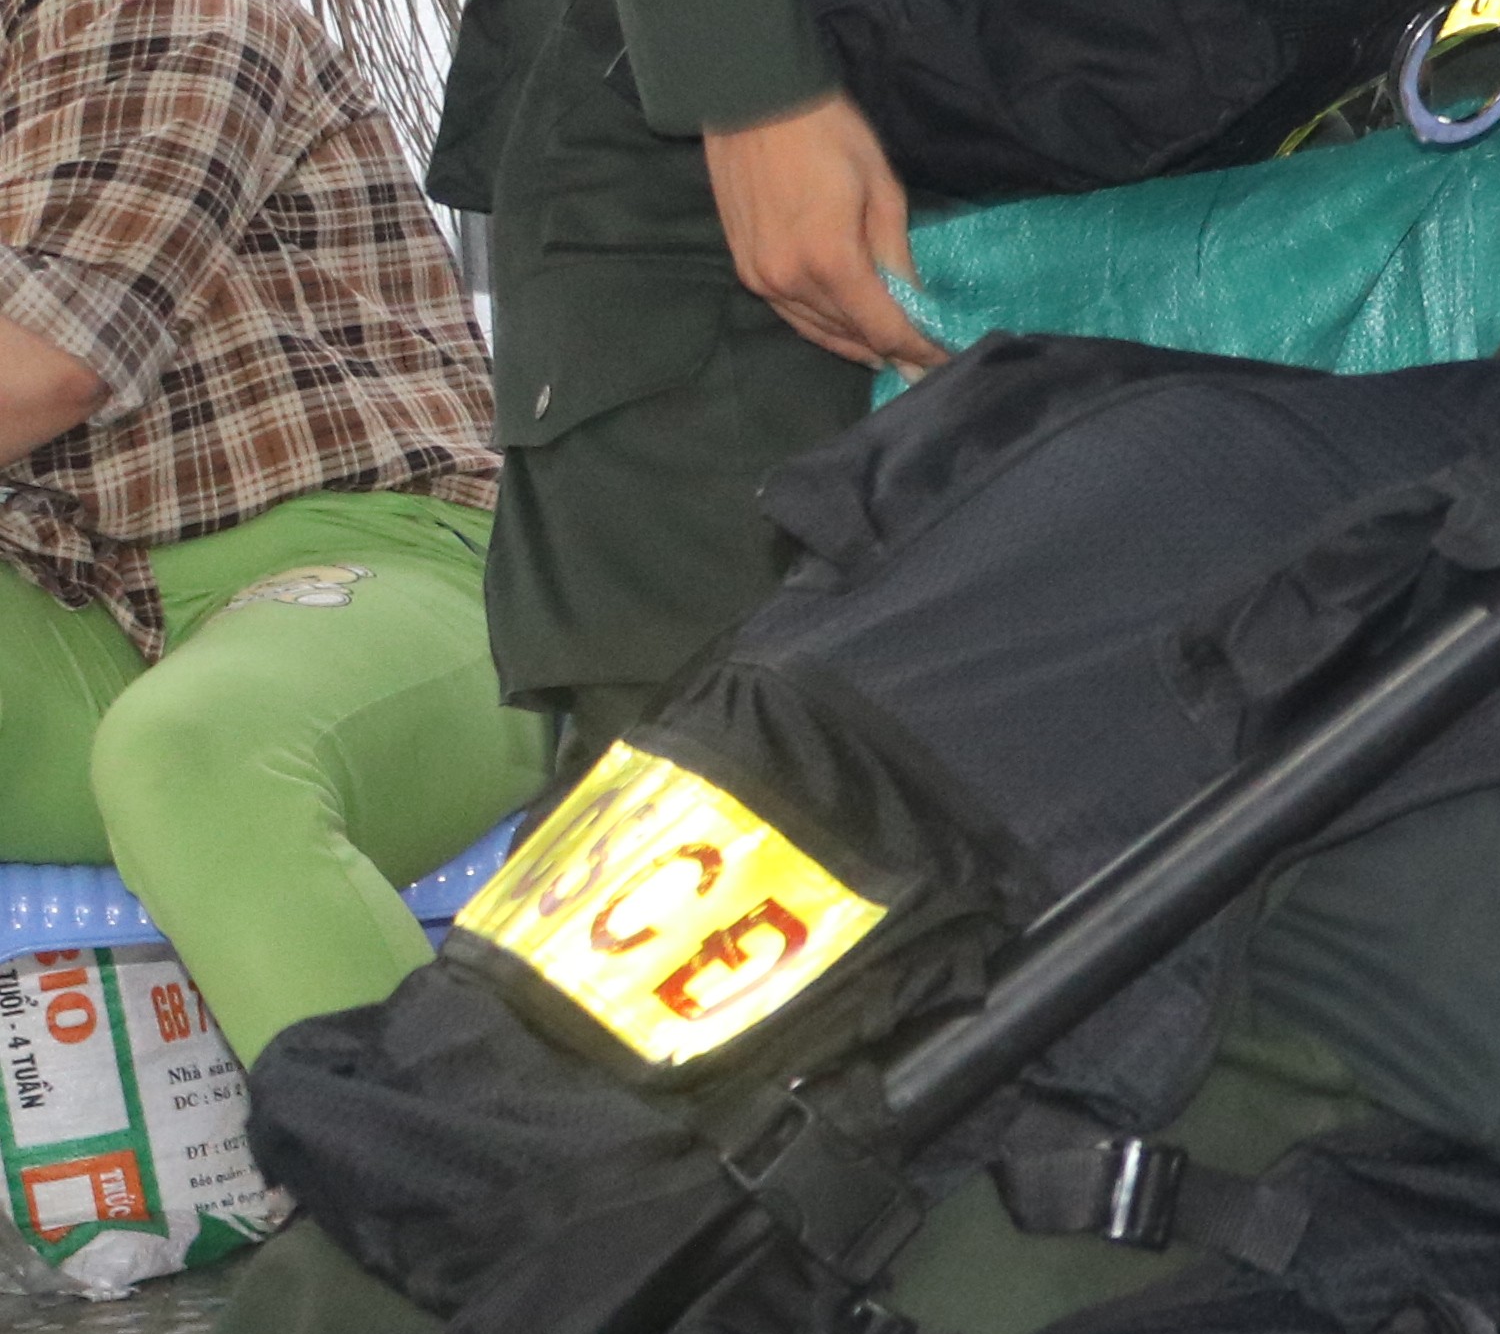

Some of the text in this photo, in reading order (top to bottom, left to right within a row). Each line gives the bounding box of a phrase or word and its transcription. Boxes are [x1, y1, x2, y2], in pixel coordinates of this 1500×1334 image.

[9, 1036, 31, 1050] 4
[12, 1053, 53, 1109] TUẦN
[167, 1064, 202, 1085] Nhà
